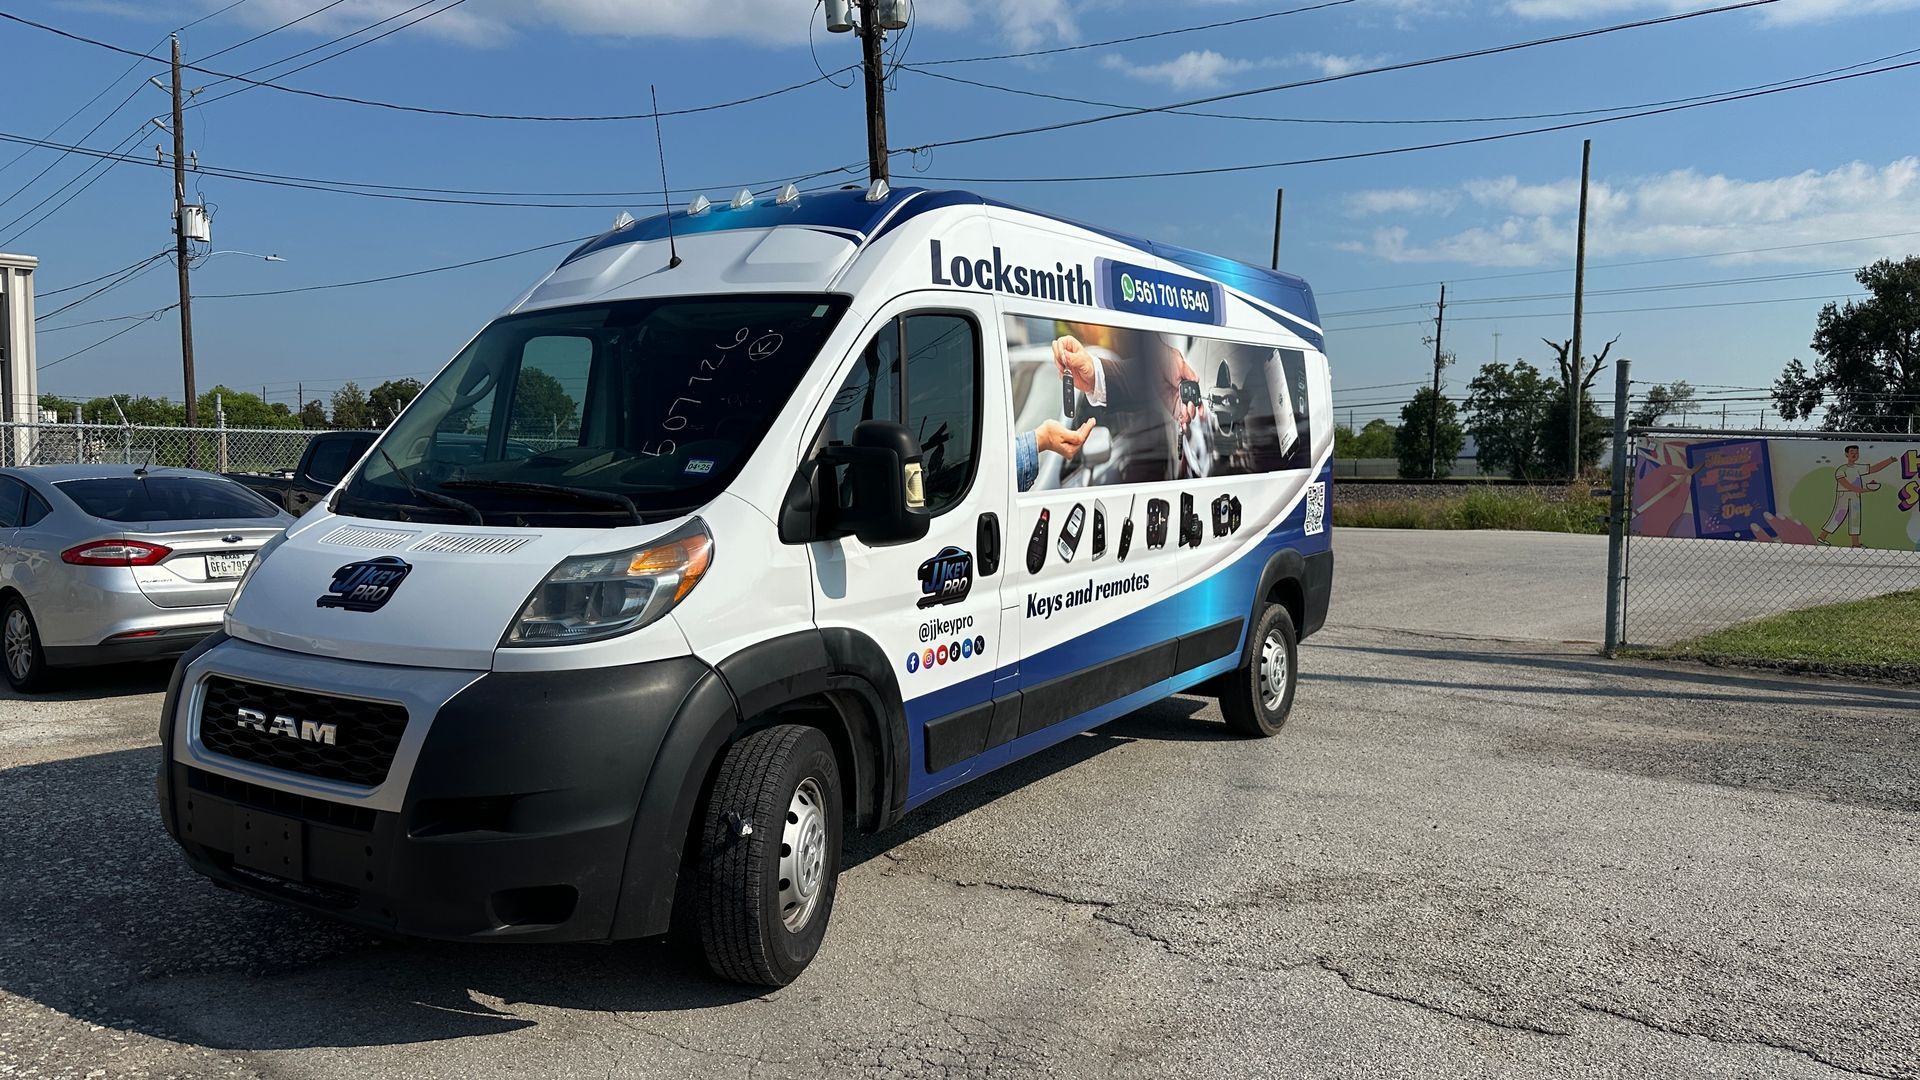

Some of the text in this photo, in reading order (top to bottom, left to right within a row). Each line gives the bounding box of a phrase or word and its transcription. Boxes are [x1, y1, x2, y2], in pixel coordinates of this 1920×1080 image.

[930, 239, 1093, 306] Locksmith
[1135, 280, 1210, 313] 561 701 6540
[348, 584, 390, 601] PRO
[942, 577, 968, 596] PRO
[1026, 574, 1150, 619] Keys and remotes
[919, 615, 974, 643] @jjkeypro
[237, 707, 337, 746] RAM
